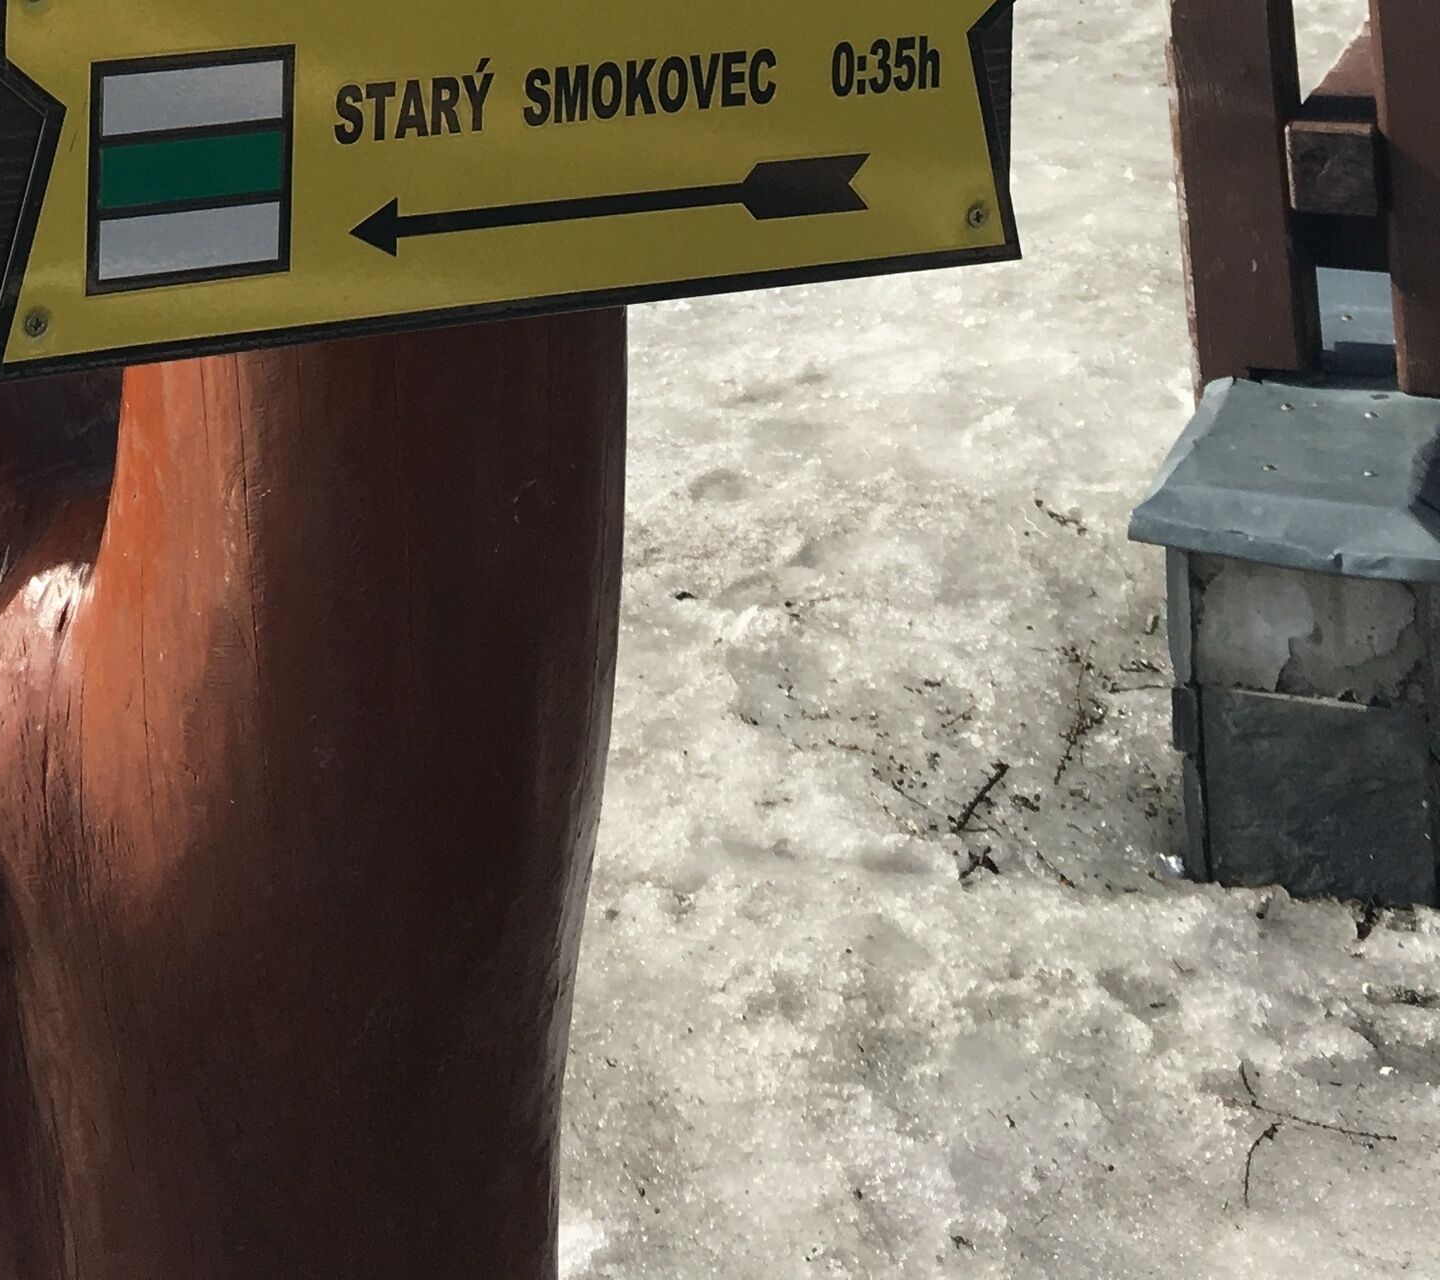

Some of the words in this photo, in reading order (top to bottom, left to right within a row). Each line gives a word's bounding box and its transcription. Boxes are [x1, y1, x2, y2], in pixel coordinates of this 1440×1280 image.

[335, 58, 494, 144] STARÝ
[524, 49, 776, 126] SMOKOVEC
[832, 36, 939, 96] 0:35h
